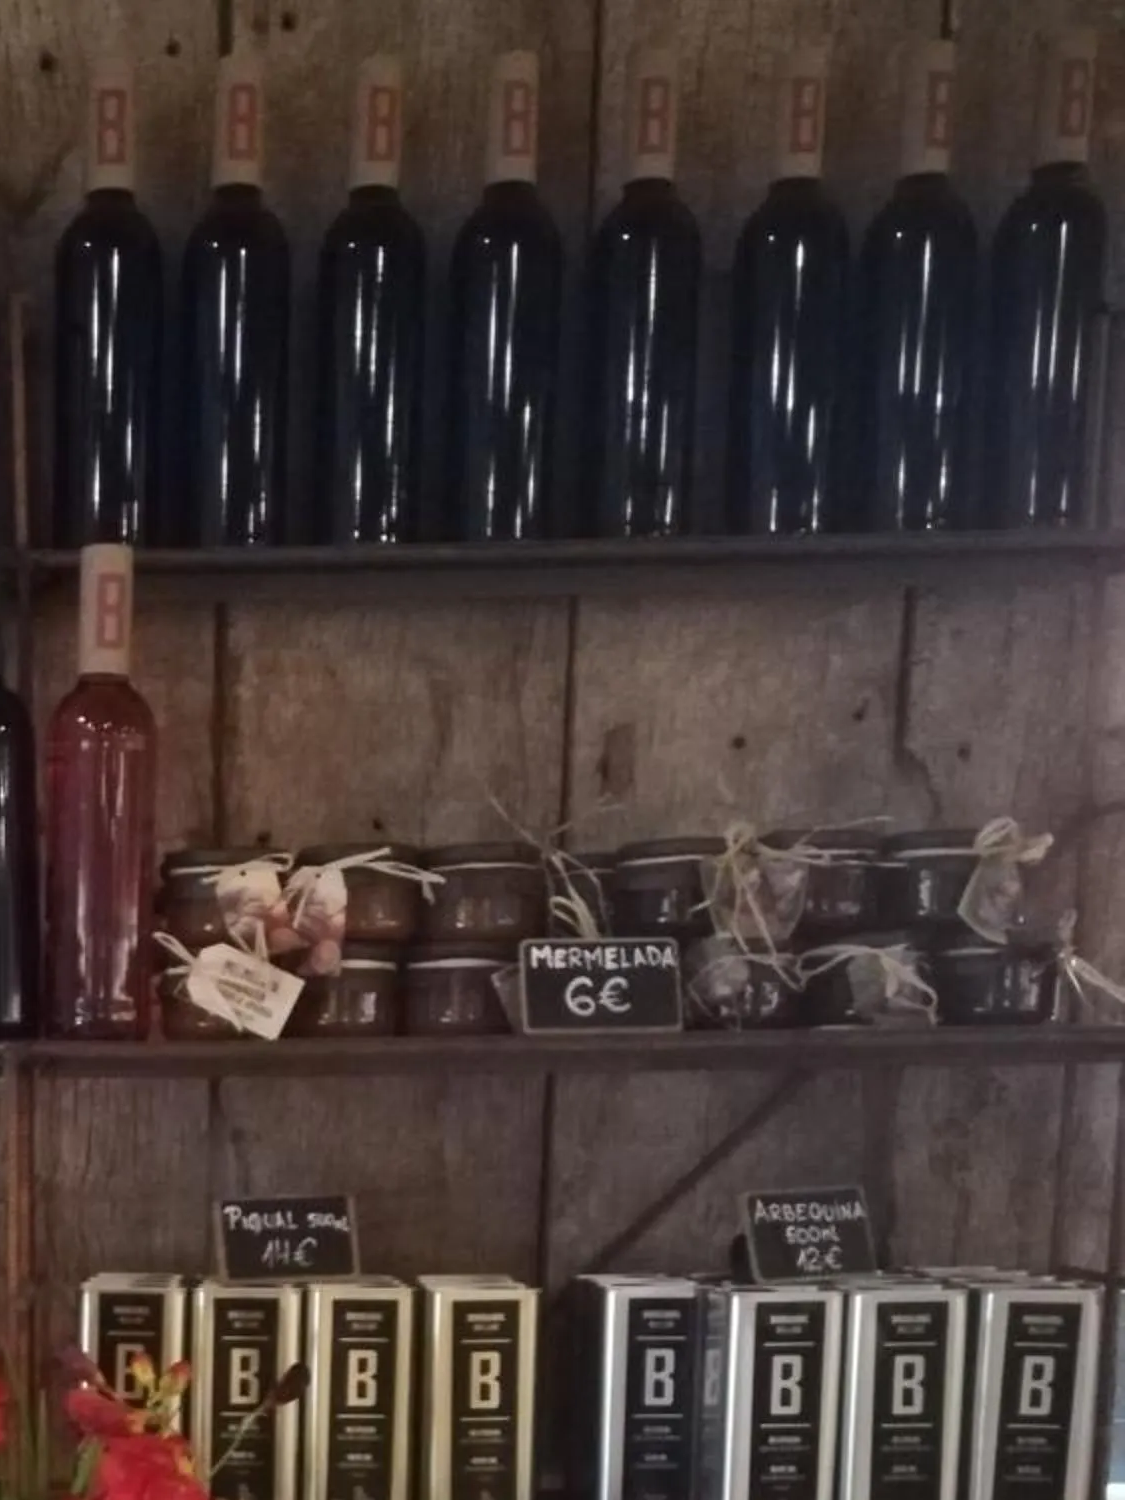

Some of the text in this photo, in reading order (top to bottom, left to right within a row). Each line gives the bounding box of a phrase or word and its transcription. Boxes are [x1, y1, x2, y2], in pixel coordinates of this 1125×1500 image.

[97, 574, 125, 647] B
[530, 945, 675, 971] MERMELADA
[565, 976, 632, 1017] 6€
[797, 1246, 842, 1271] 12€
[231, 1348, 260, 1404] B
[347, 1349, 378, 1407] B
[470, 1351, 501, 1409] B
[644, 1348, 674, 1406] B
[771, 1355, 802, 1416] B
[892, 1355, 924, 1415] B
[1020, 1356, 1055, 1416] B
